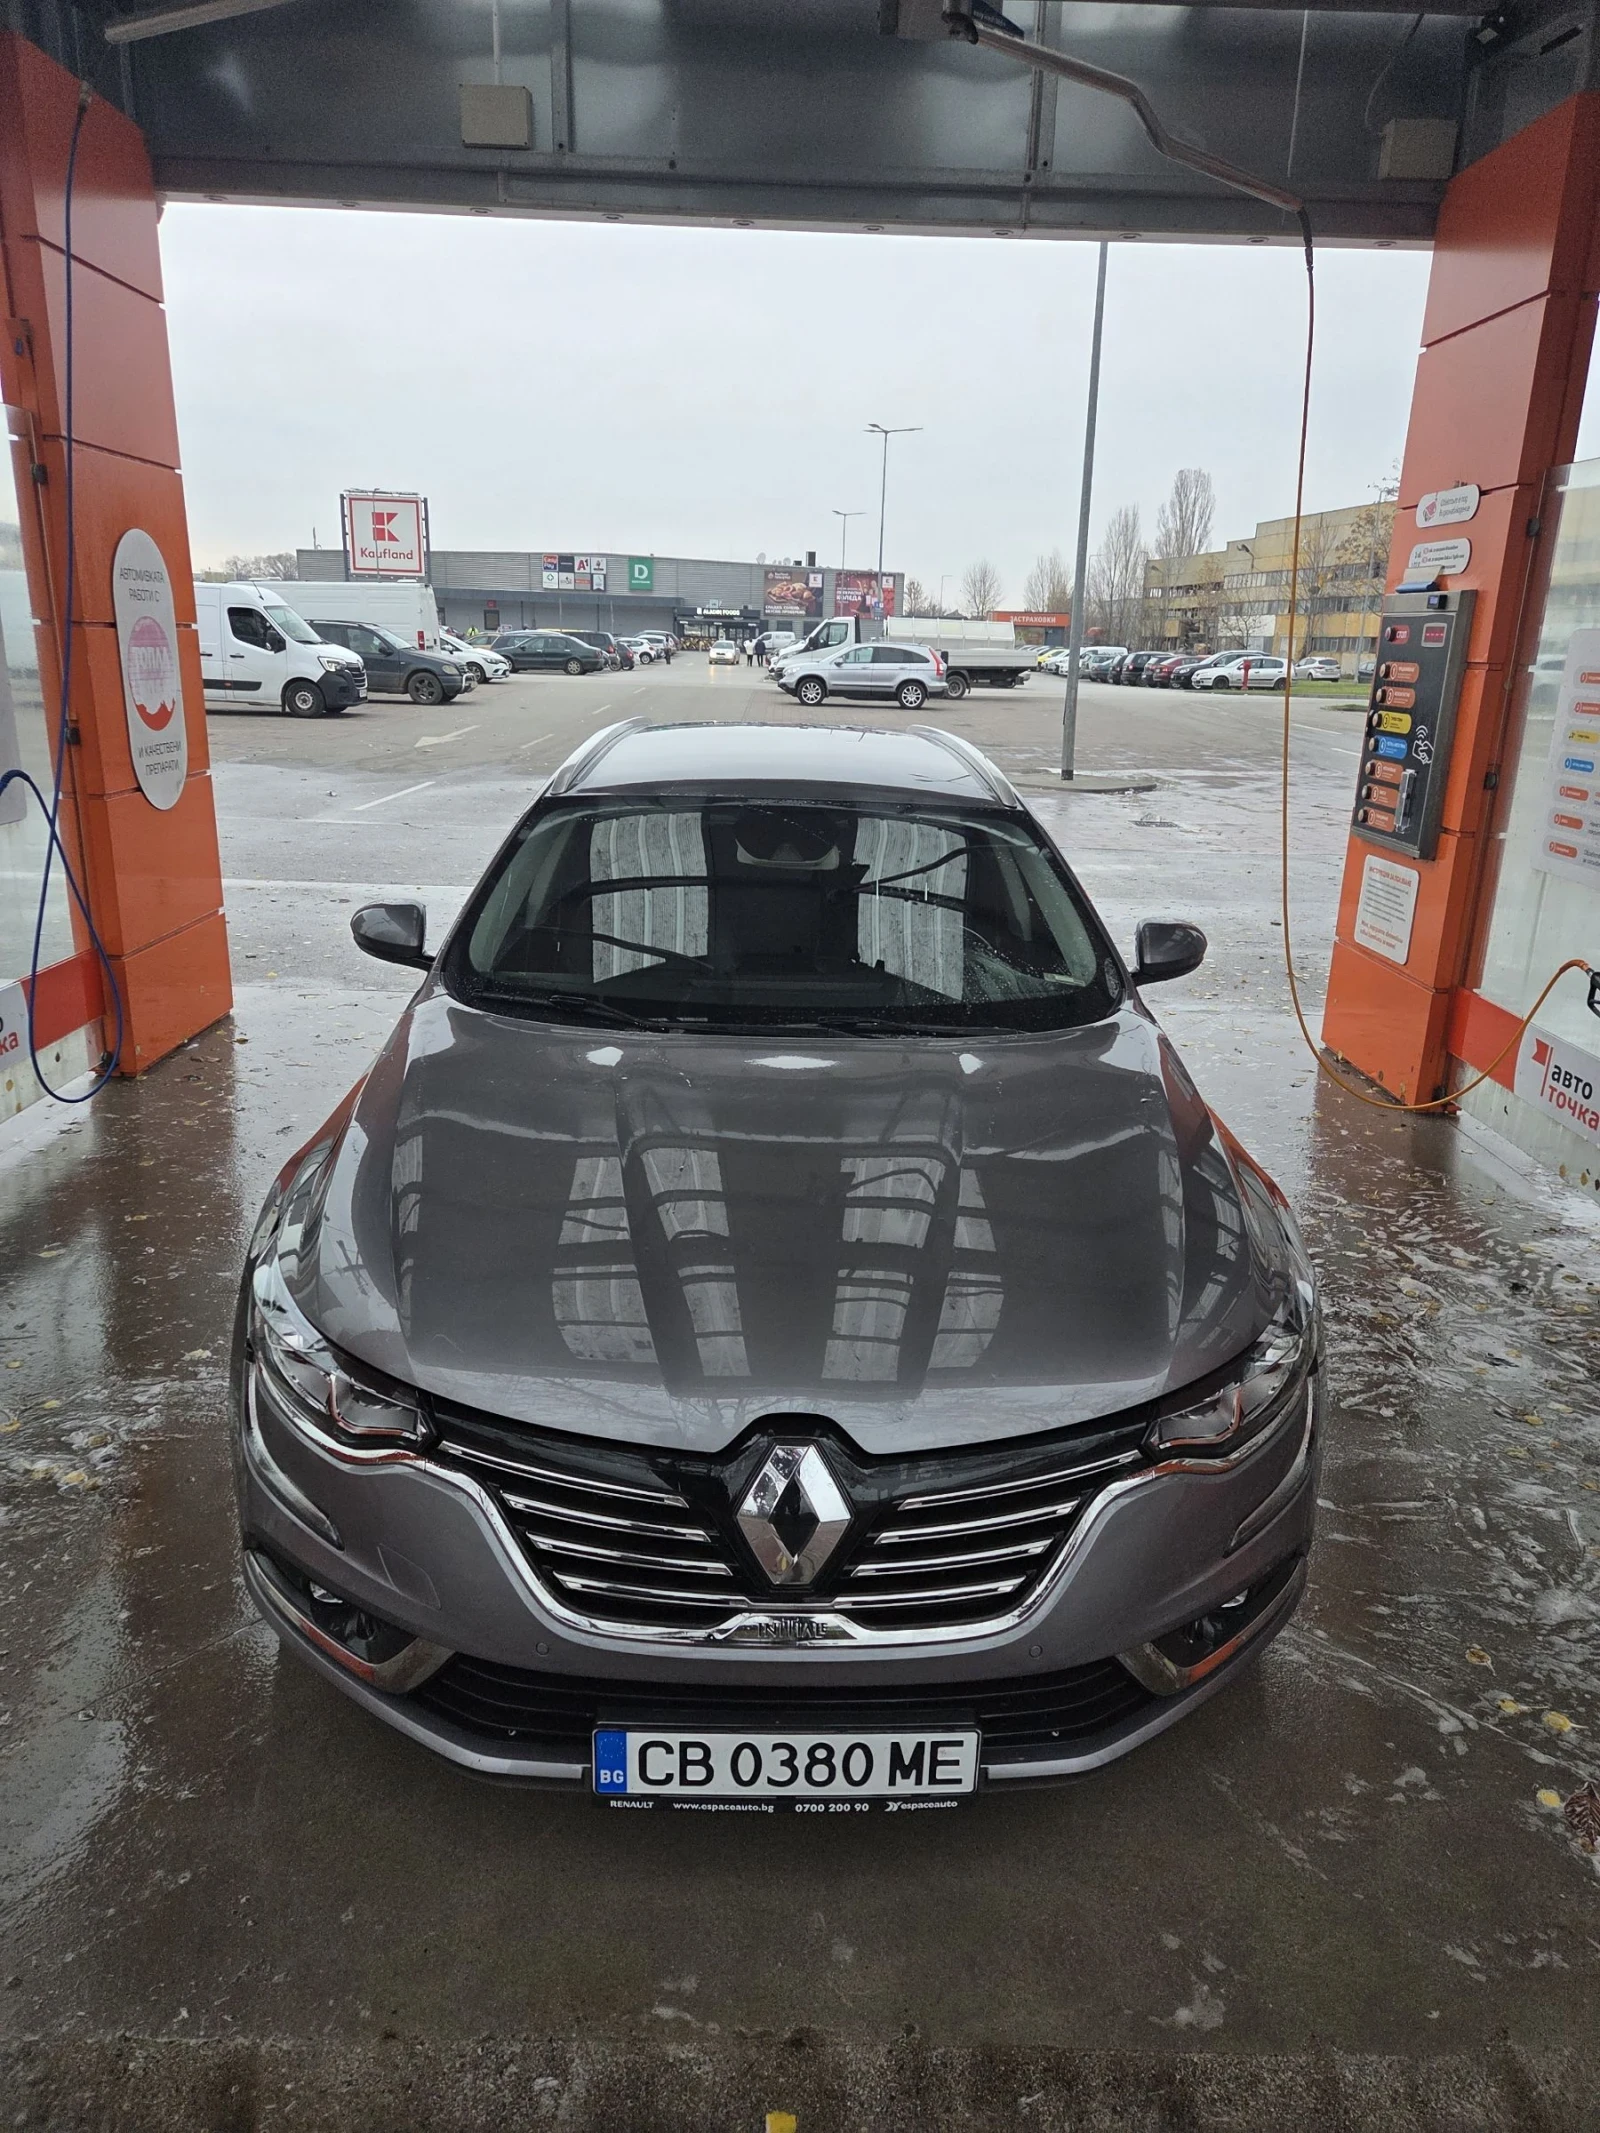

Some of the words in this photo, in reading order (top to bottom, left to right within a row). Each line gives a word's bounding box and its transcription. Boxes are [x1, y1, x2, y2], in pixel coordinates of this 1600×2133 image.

[360, 547, 414, 560] Kaufland
[576, 558, 589, 571] A1
[634, 564, 649, 579] D
[120, 567, 164, 583] АВТОМИВКАТА
[129, 588, 153, 602] РАБОТИ
[1010, 615, 1056, 624] ЗАСТРАХОВКИ
[1396, 630, 1408, 639] СТОП
[138, 746, 144, 758] И
[145, 741, 181, 757] КАЧЕСТВЕНИ
[145, 759, 179, 776] ПРЕПАРАТИ
[1551, 1064, 1593, 1100] авто
[1548, 1086, 1600, 1132] точка
[757, 1617, 828, 1639] INITIALE
[600, 1769, 624, 1784] BG
[638, 1740, 715, 1787] CB
[730, 1741, 874, 1788] 0380
[888, 1740, 964, 1787] ME
[610, 1801, 654, 1809] RENAULT
[673, 1801, 775, 1813] www.espaceauto.bg
[795, 1803, 826, 1813] 0700
[828, 1803, 851, 1813] 200
[854, 1803, 869, 1812] 90
[901, 1800, 958, 1811] espaceauto
